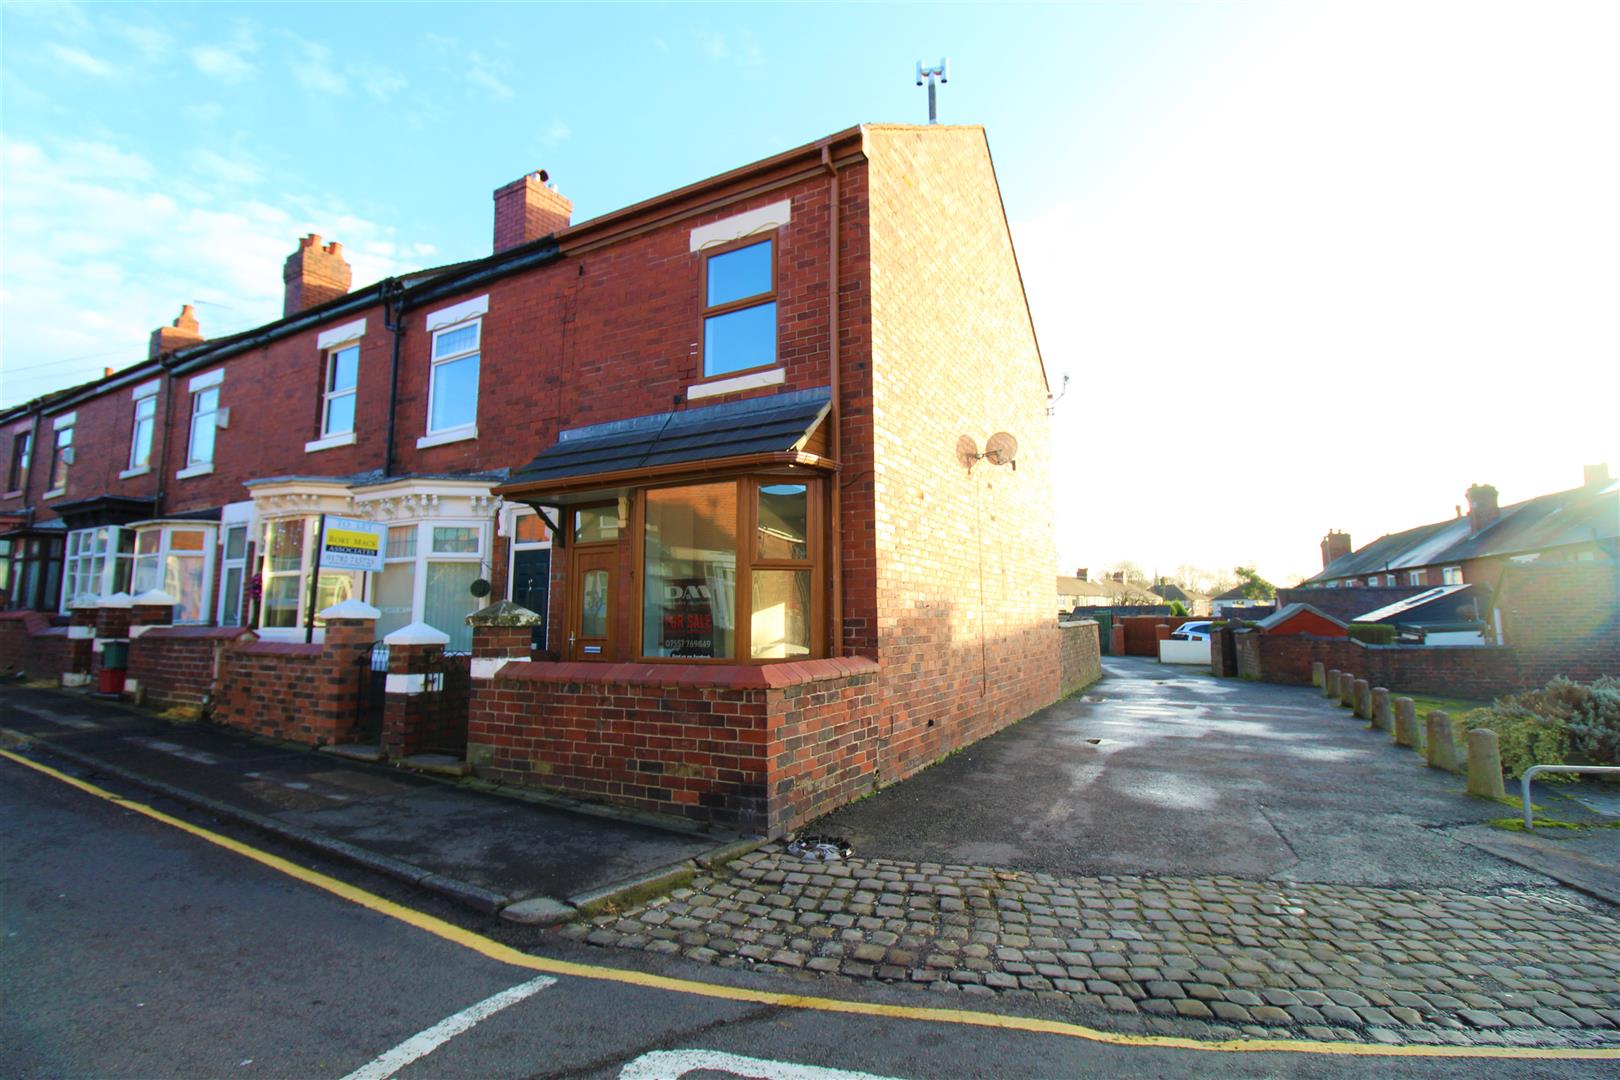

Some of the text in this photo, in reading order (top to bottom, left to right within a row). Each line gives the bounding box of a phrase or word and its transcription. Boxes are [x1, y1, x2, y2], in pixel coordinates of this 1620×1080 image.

[337, 520, 372, 531] TO LET
[328, 546, 376, 555] ASSOCIATES
[687, 613, 711, 629] SALE
